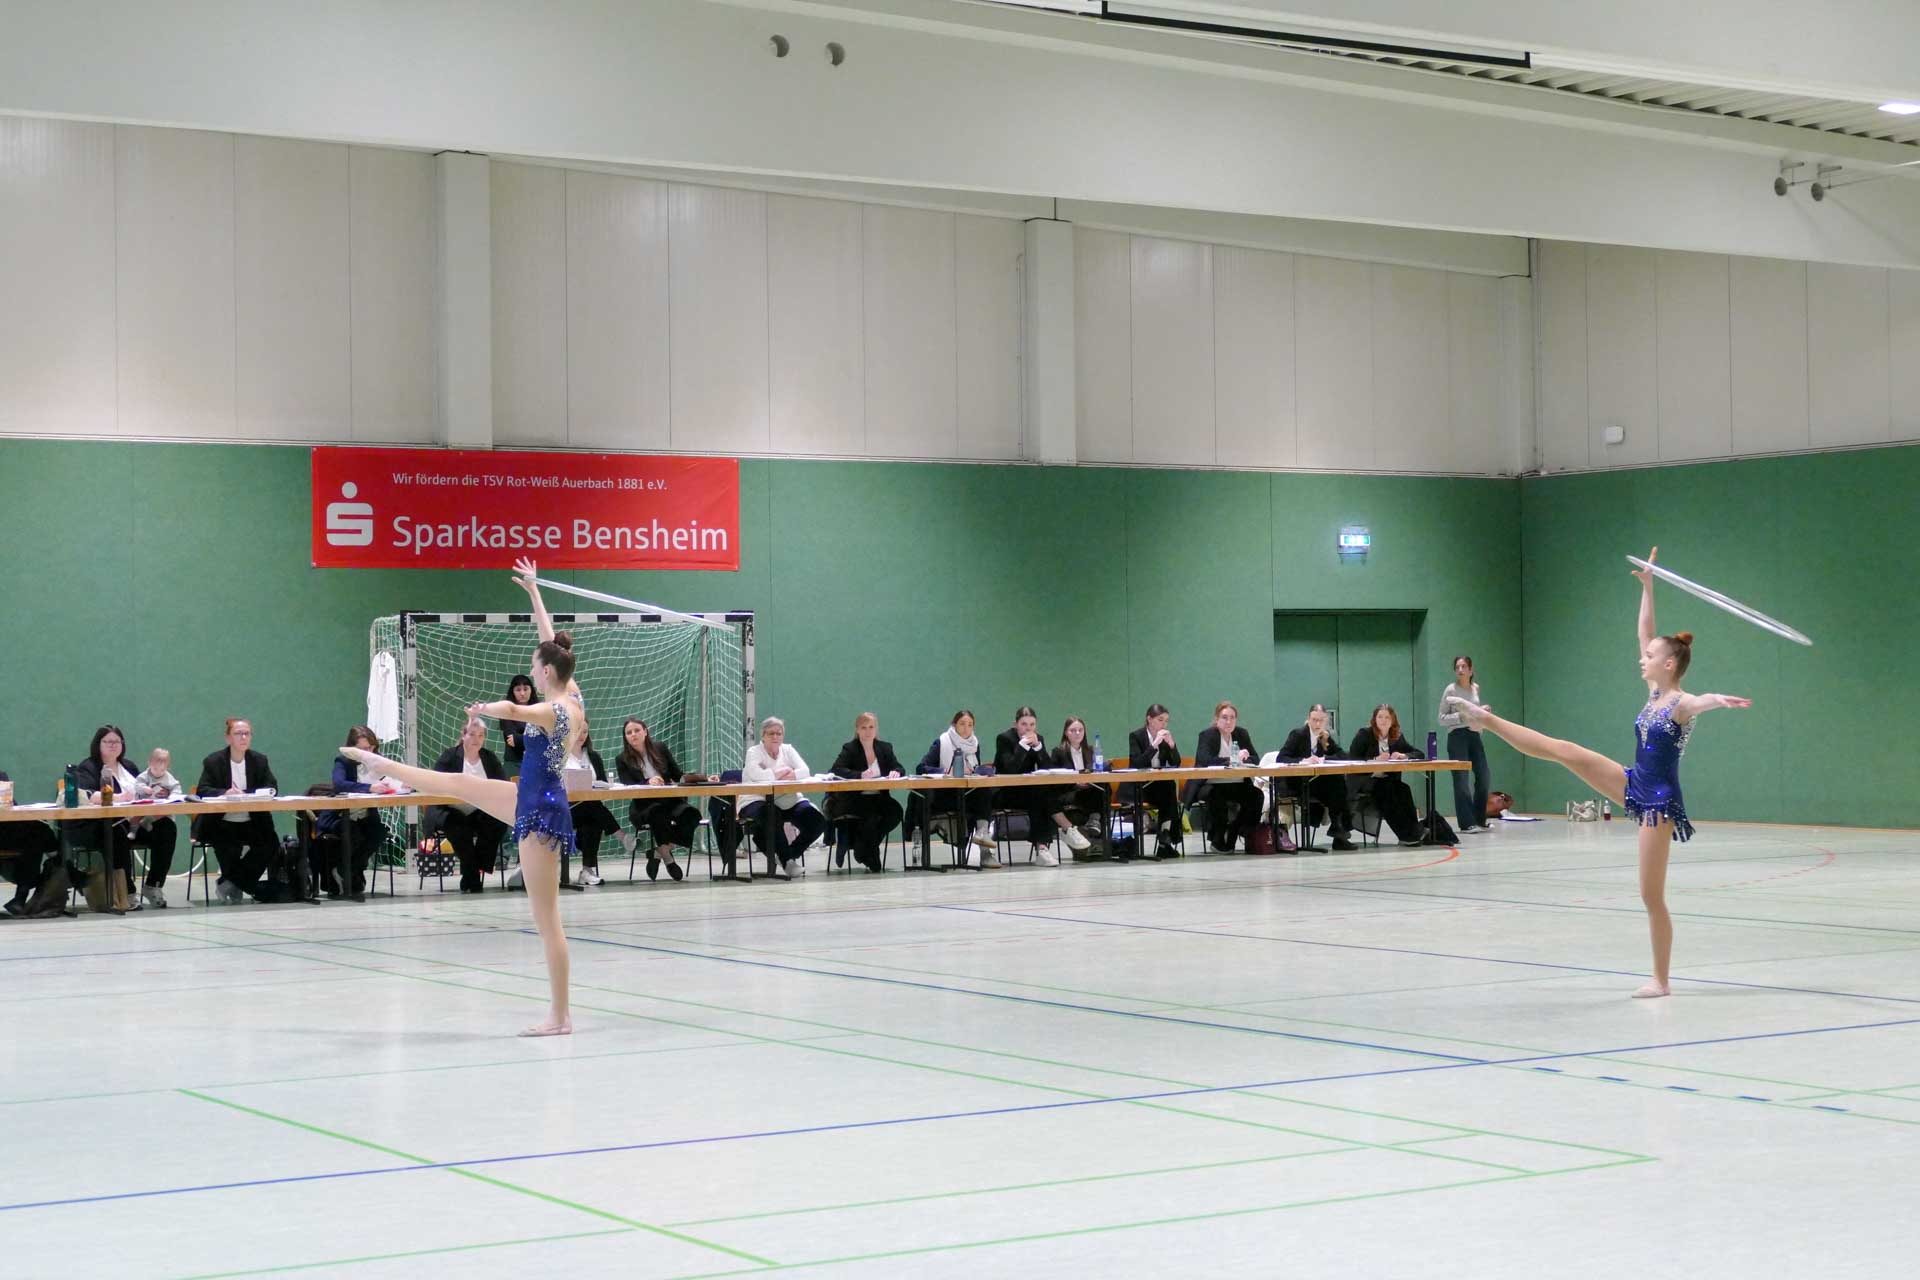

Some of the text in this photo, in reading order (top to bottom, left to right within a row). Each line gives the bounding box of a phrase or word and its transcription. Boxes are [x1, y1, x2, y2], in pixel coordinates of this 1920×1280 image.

[392, 473, 668, 491] Wir fördern die TSV Rot-Weiß Auerbach 1881 e.V.
[392, 515, 729, 555] Sparkasse Bensheim
